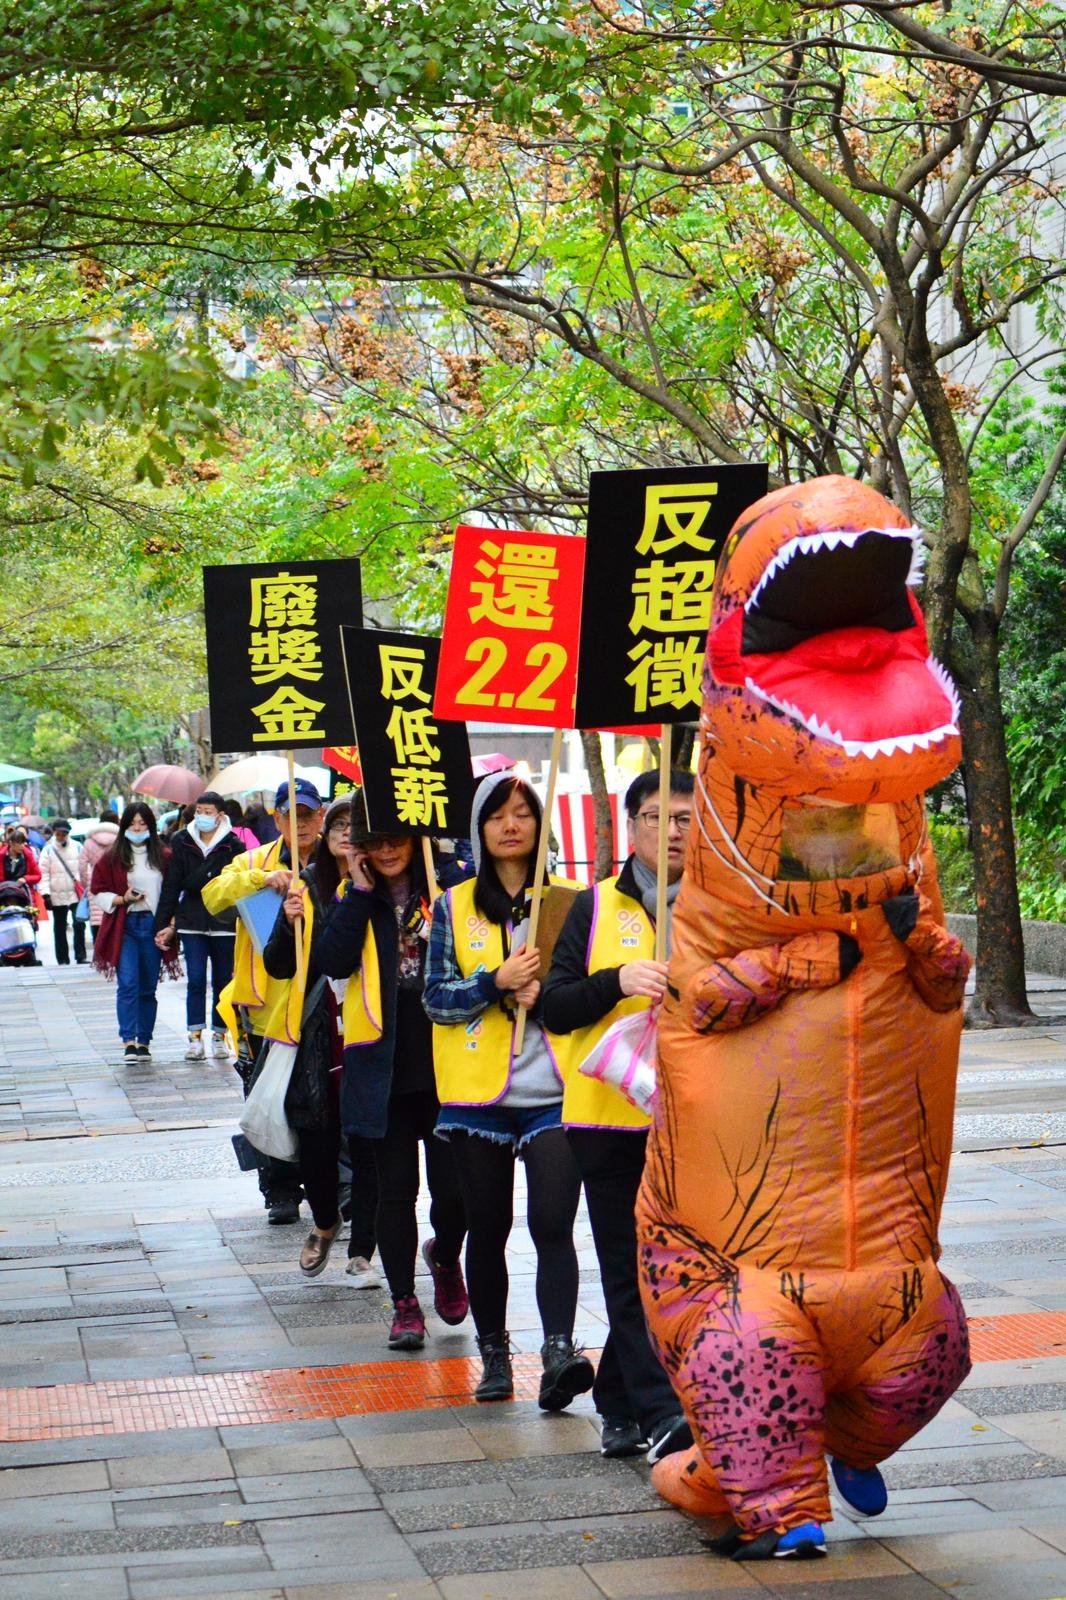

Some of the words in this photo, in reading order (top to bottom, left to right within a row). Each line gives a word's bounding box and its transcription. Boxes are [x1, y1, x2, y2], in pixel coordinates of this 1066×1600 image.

[467, 540, 560, 631] 還
[624, 482, 718, 713] 反超徵
[378, 644, 449, 828] 反低薪
[455, 637, 577, 711] 2.2
